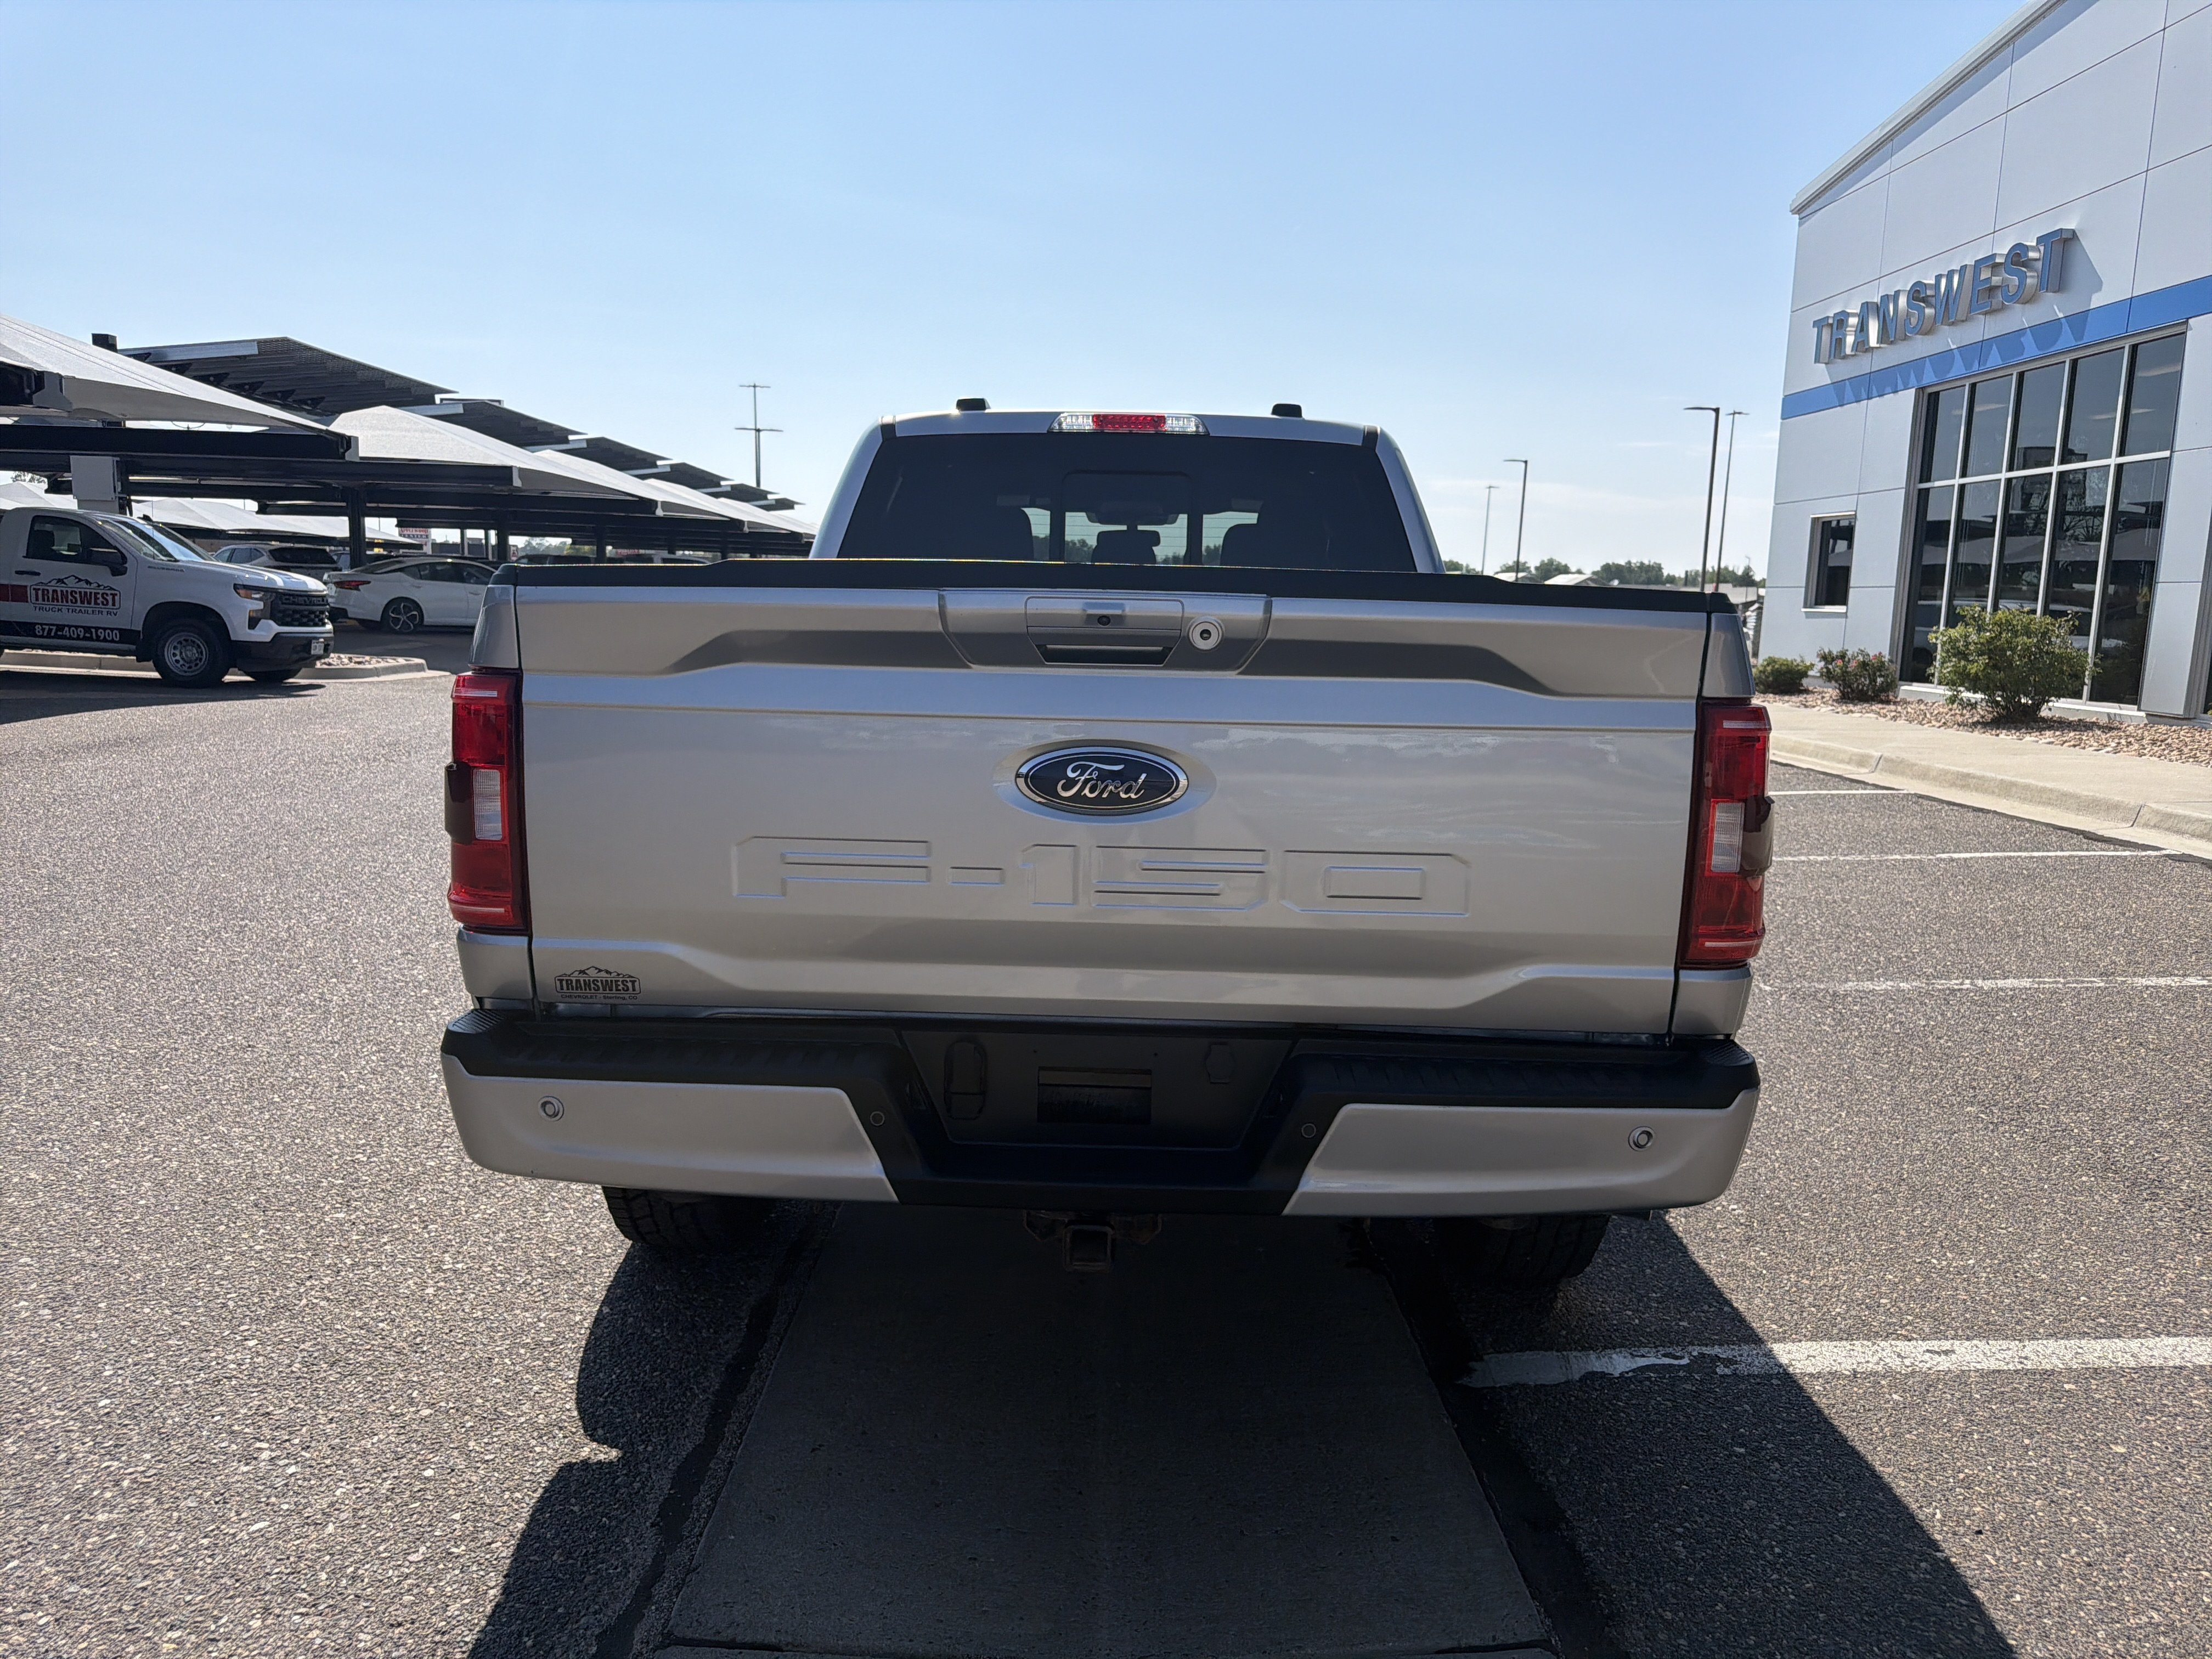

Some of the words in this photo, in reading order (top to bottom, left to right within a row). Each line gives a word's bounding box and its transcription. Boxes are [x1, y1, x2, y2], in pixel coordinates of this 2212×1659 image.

[1813, 228, 2075, 364] TRANSWEST
[32, 588, 118, 607] TRANSWEST
[66, 607, 104, 616] TRAILER
[35, 624, 120, 641] 877-409-1900
[1057, 761, 1148, 799] Ford
[731, 836, 1472, 917] F-150
[556, 978, 637, 992] TRANSWEST
